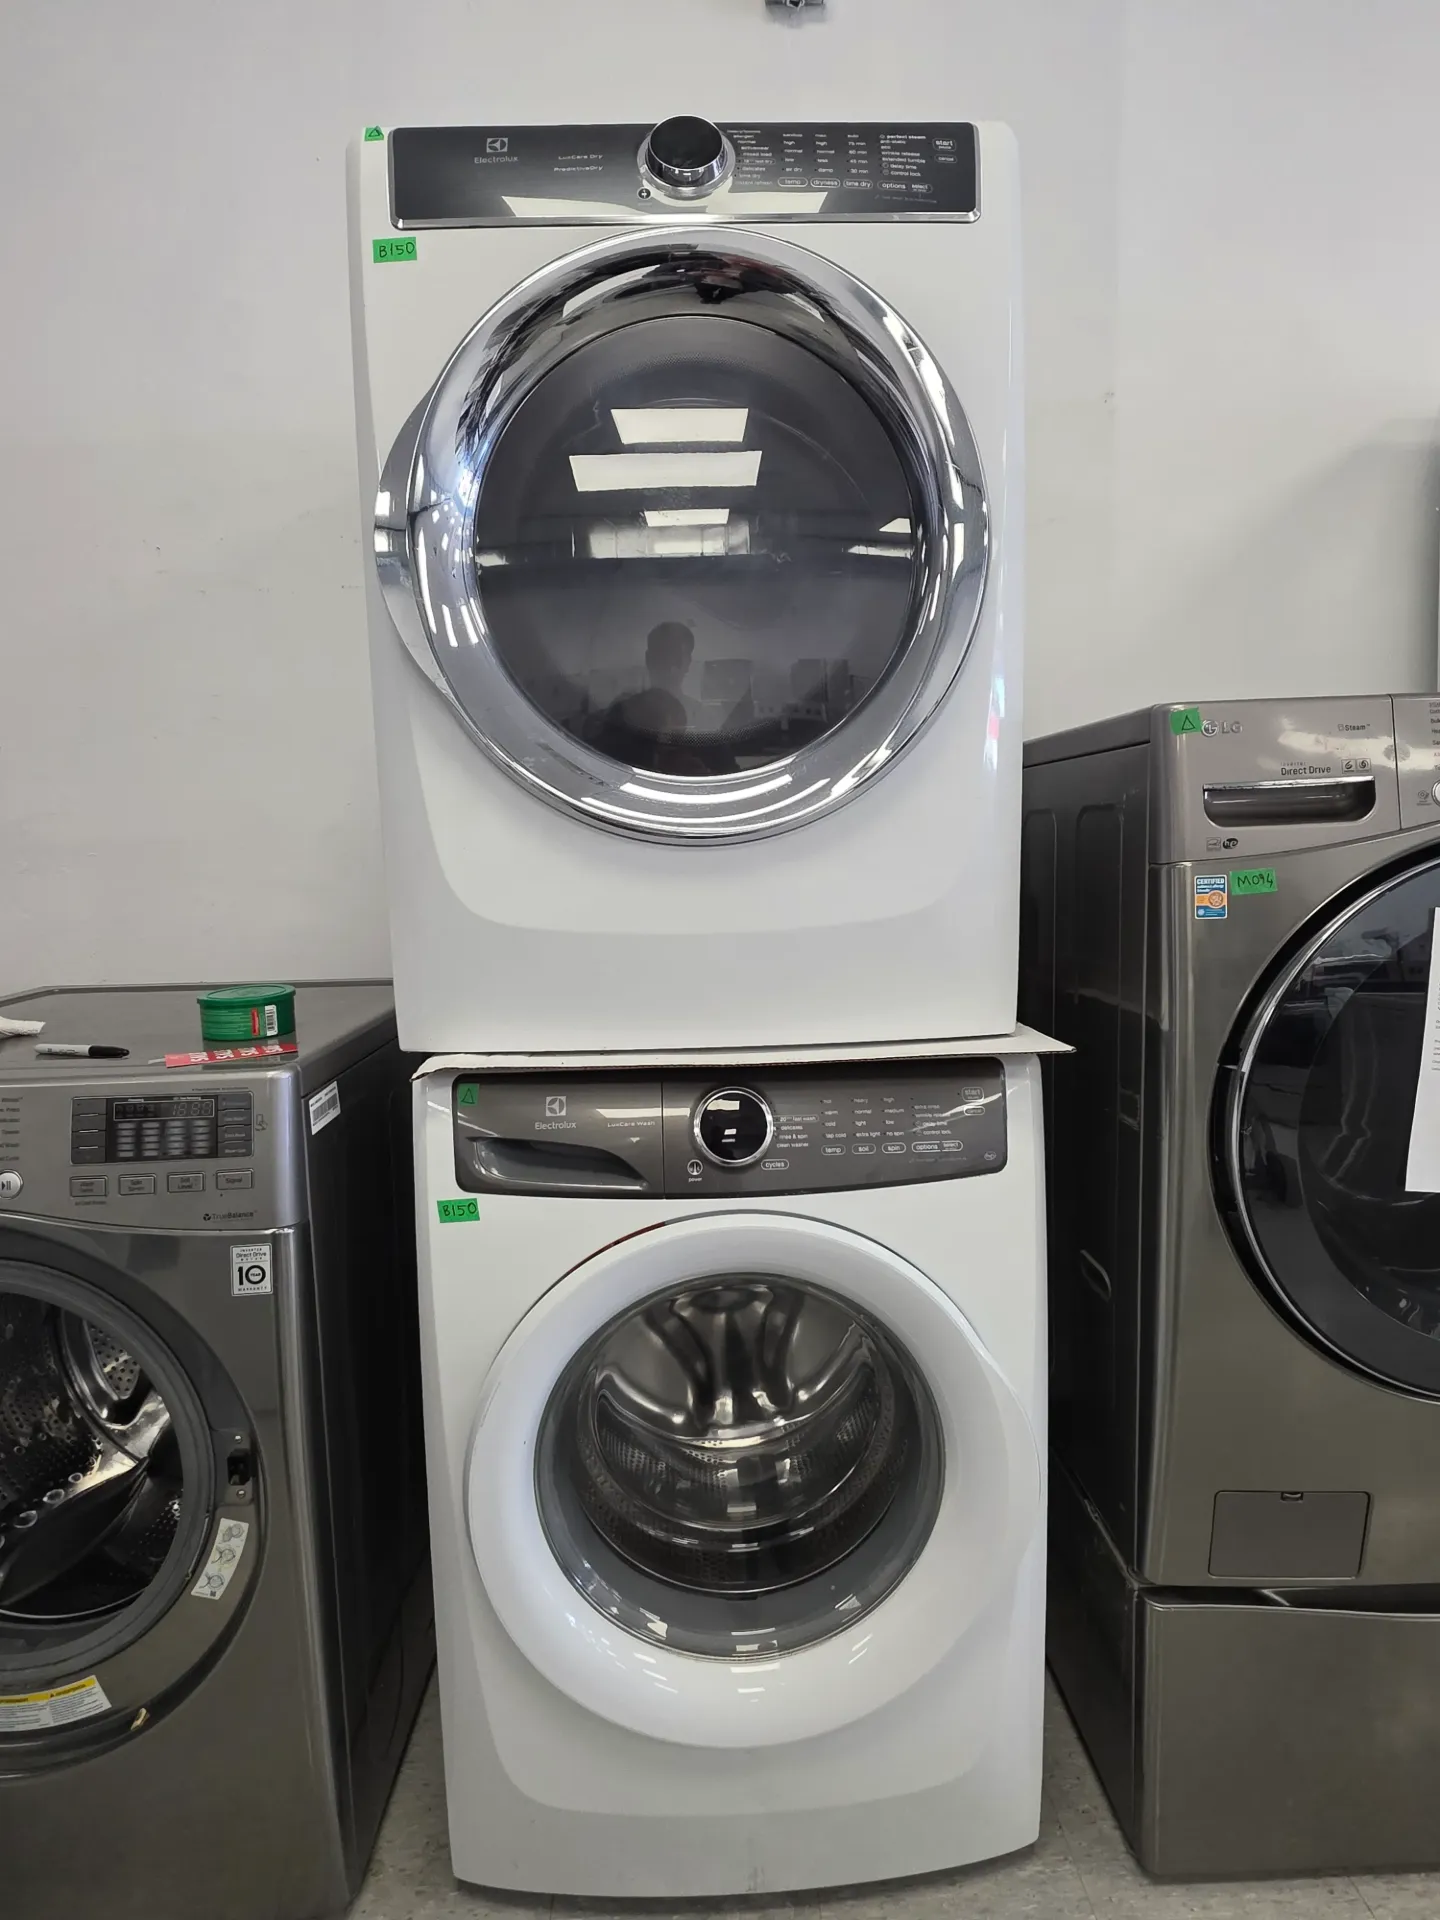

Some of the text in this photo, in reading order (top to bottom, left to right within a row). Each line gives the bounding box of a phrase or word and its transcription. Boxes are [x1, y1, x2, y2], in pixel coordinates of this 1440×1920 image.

[474, 156, 519, 165] Electrolux
[882, 182, 906, 190] options
[379, 241, 415, 258] B150
[1221, 721, 1243, 734] LG
[1280, 766, 1331, 776] Direct Drive
[1237, 873, 1274, 888] M094
[534, 1120, 577, 1130] Electrolux
[765, 1161, 785, 1169] cycles
[442, 1202, 477, 1216] B150
[238, 1265, 266, 1285] 10
